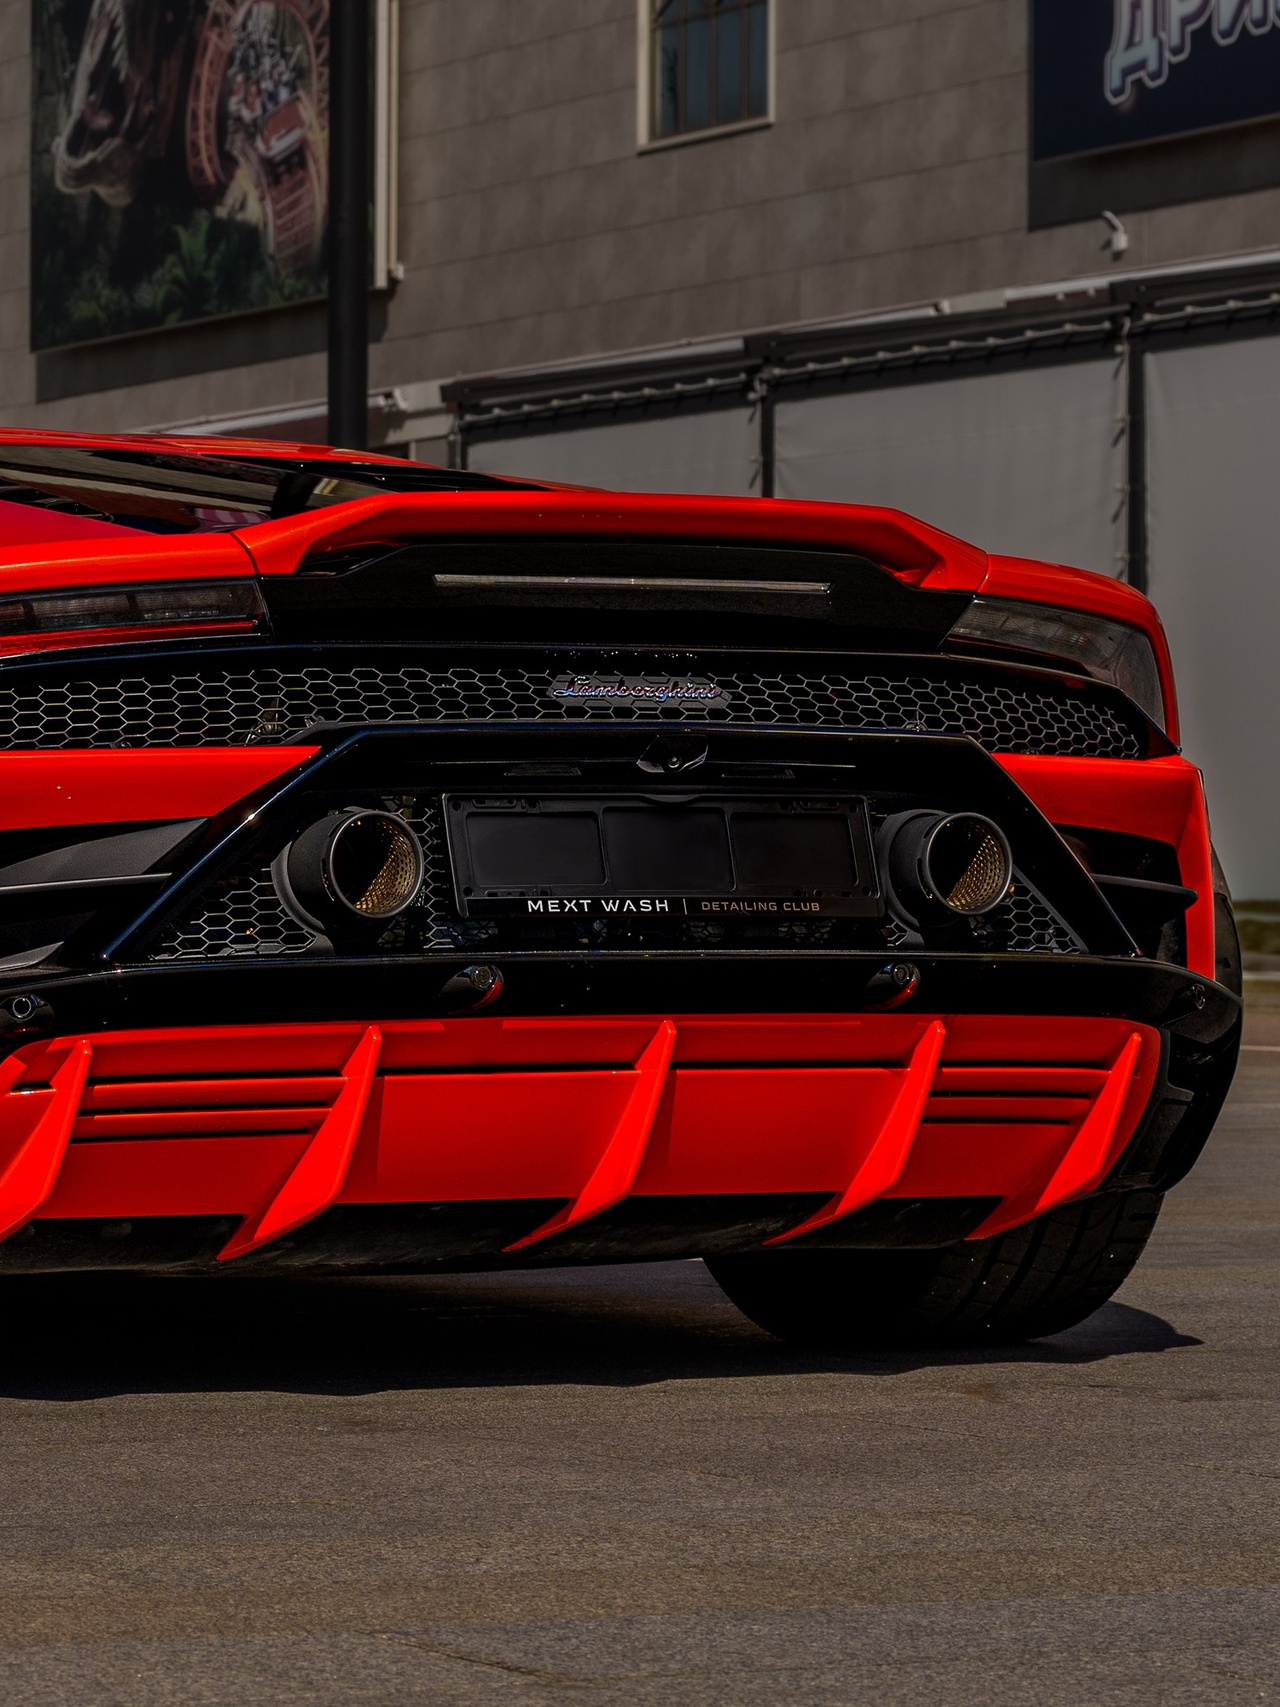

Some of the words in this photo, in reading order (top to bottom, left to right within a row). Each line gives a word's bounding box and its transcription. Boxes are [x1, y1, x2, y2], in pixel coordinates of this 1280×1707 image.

[1104, 0, 1280, 105] ДРИ
[553, 675, 717, 702] Lamborghini
[527, 900, 592, 913] MEXT
[601, 900, 669, 913] WASH
[701, 901, 778, 912] DETAILING
[782, 901, 821, 912] CLUB
